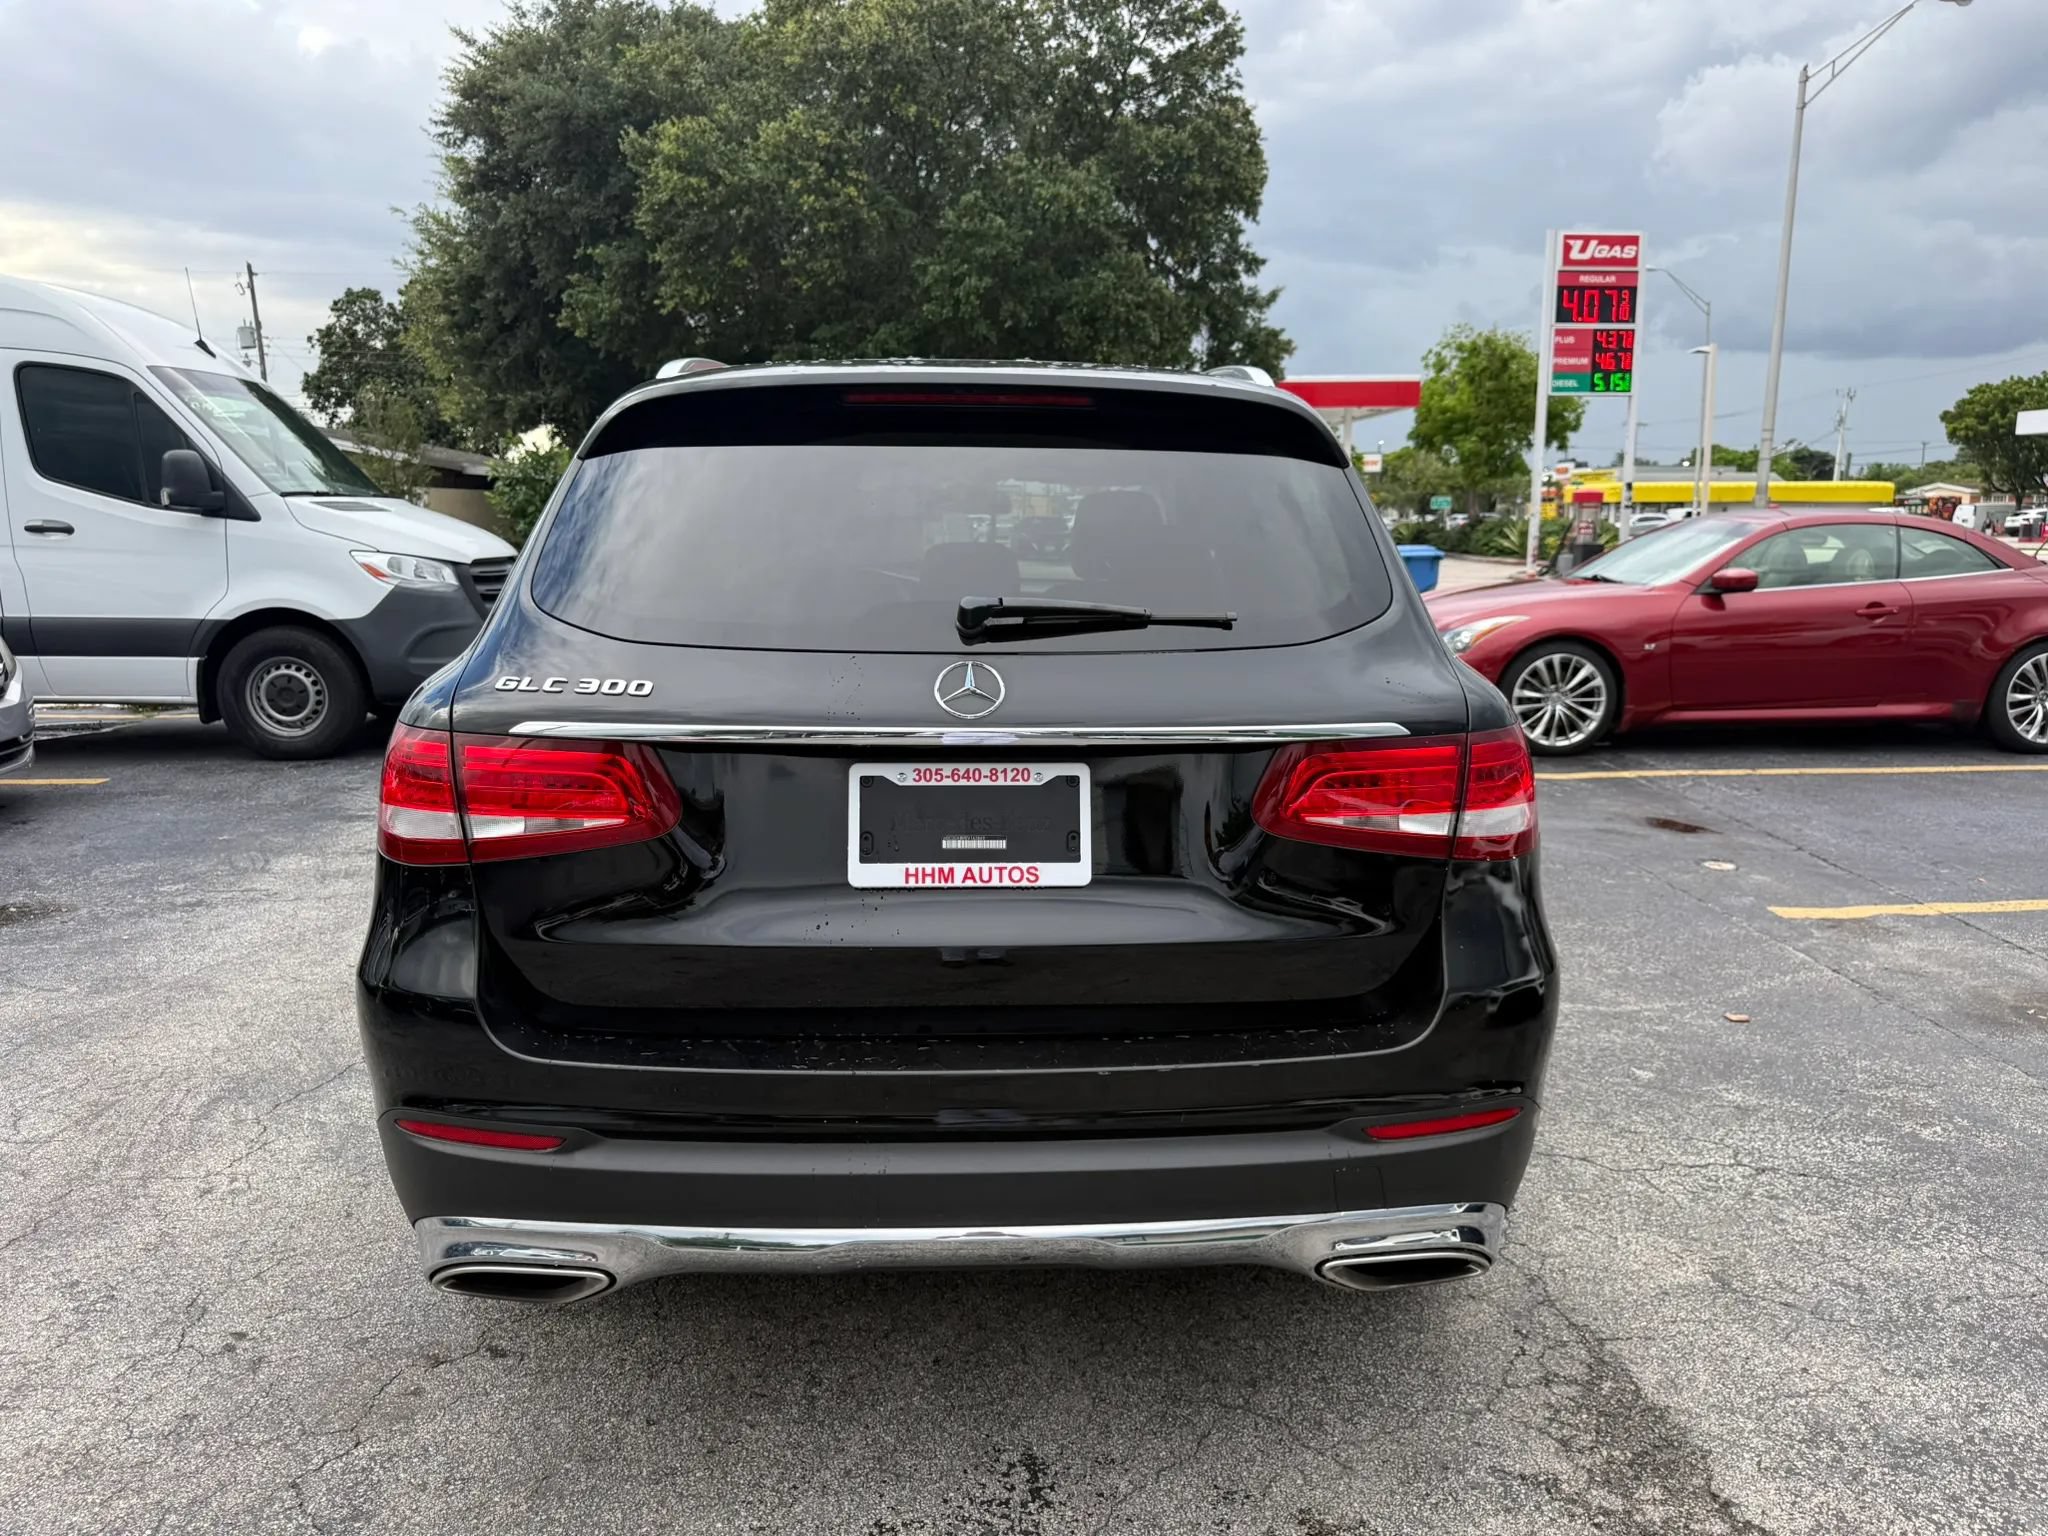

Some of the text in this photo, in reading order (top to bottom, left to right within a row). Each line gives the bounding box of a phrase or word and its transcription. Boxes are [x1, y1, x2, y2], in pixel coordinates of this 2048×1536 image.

[1565, 239, 1638, 260] UGAS
[1578, 274, 1617, 284] REGULAR
[1554, 335, 1576, 345] PLUS
[1552, 357, 1589, 366] PREMIUM
[1551, 379, 1579, 388] DIESEL
[494, 676, 654, 697] GLC 300
[912, 767, 1031, 783] 305-640-8120
[904, 866, 1040, 885] HHM AUTOS
